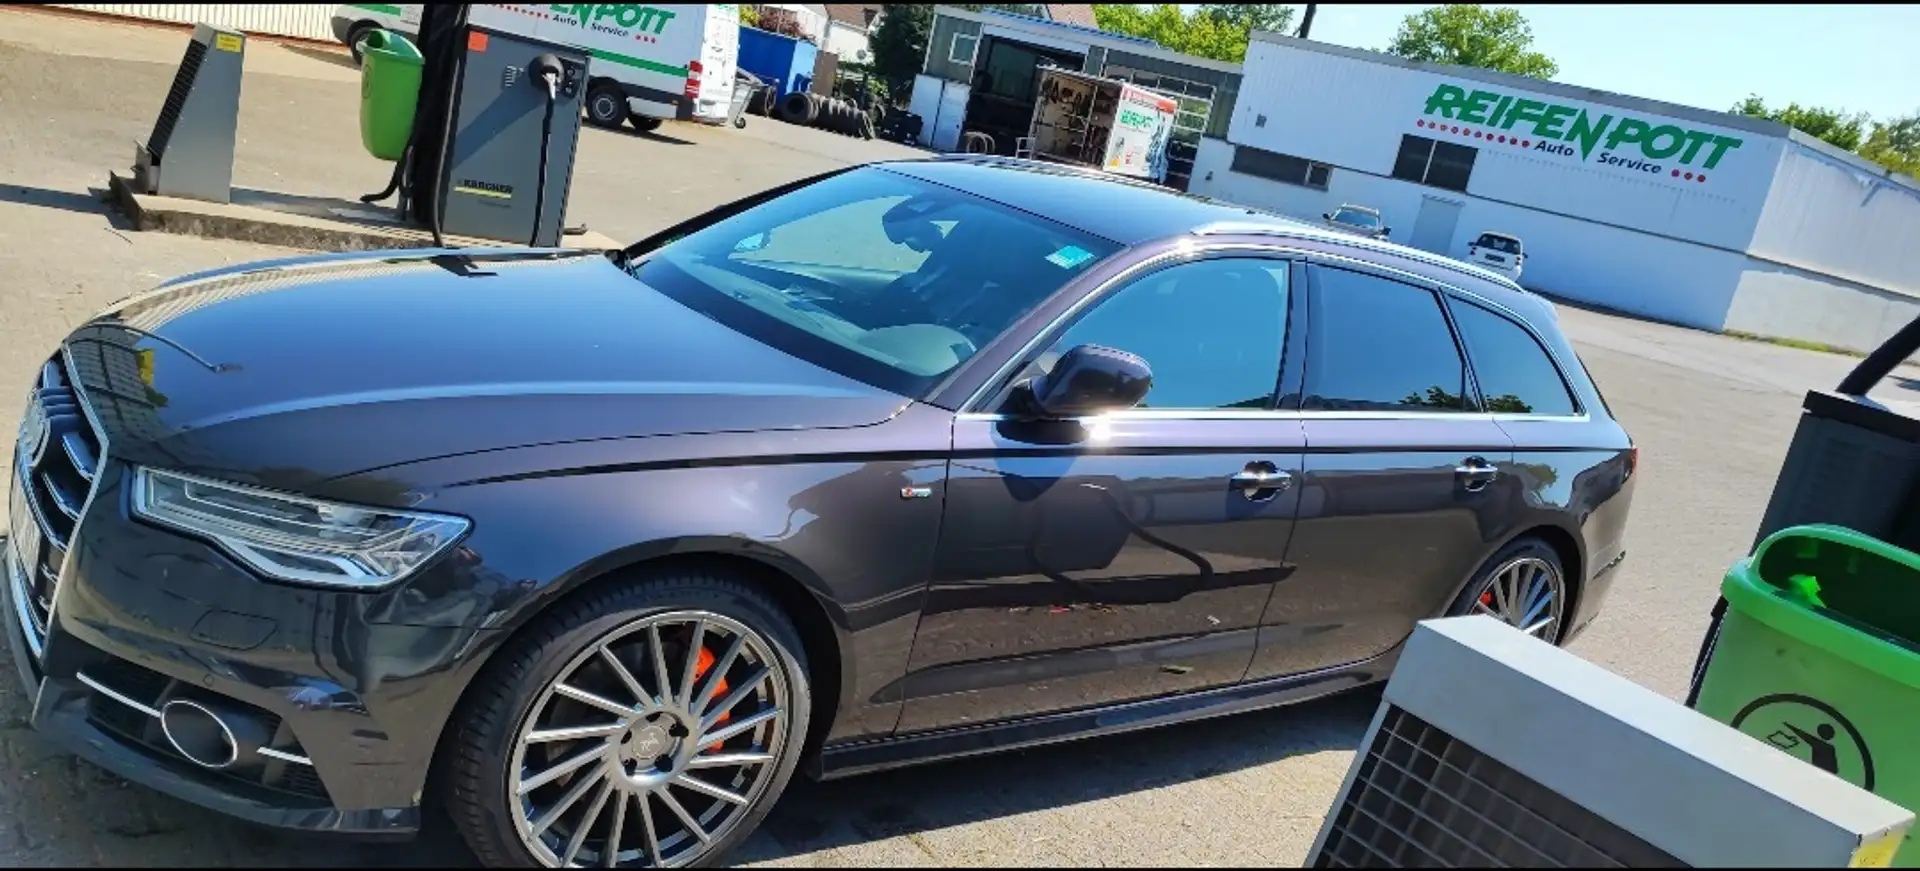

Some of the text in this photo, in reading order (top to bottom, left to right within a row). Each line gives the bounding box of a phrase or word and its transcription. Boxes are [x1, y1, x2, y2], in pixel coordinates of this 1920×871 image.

[553, 14, 629, 37] Auto Service
[1534, 140, 1662, 174] Auto Service
